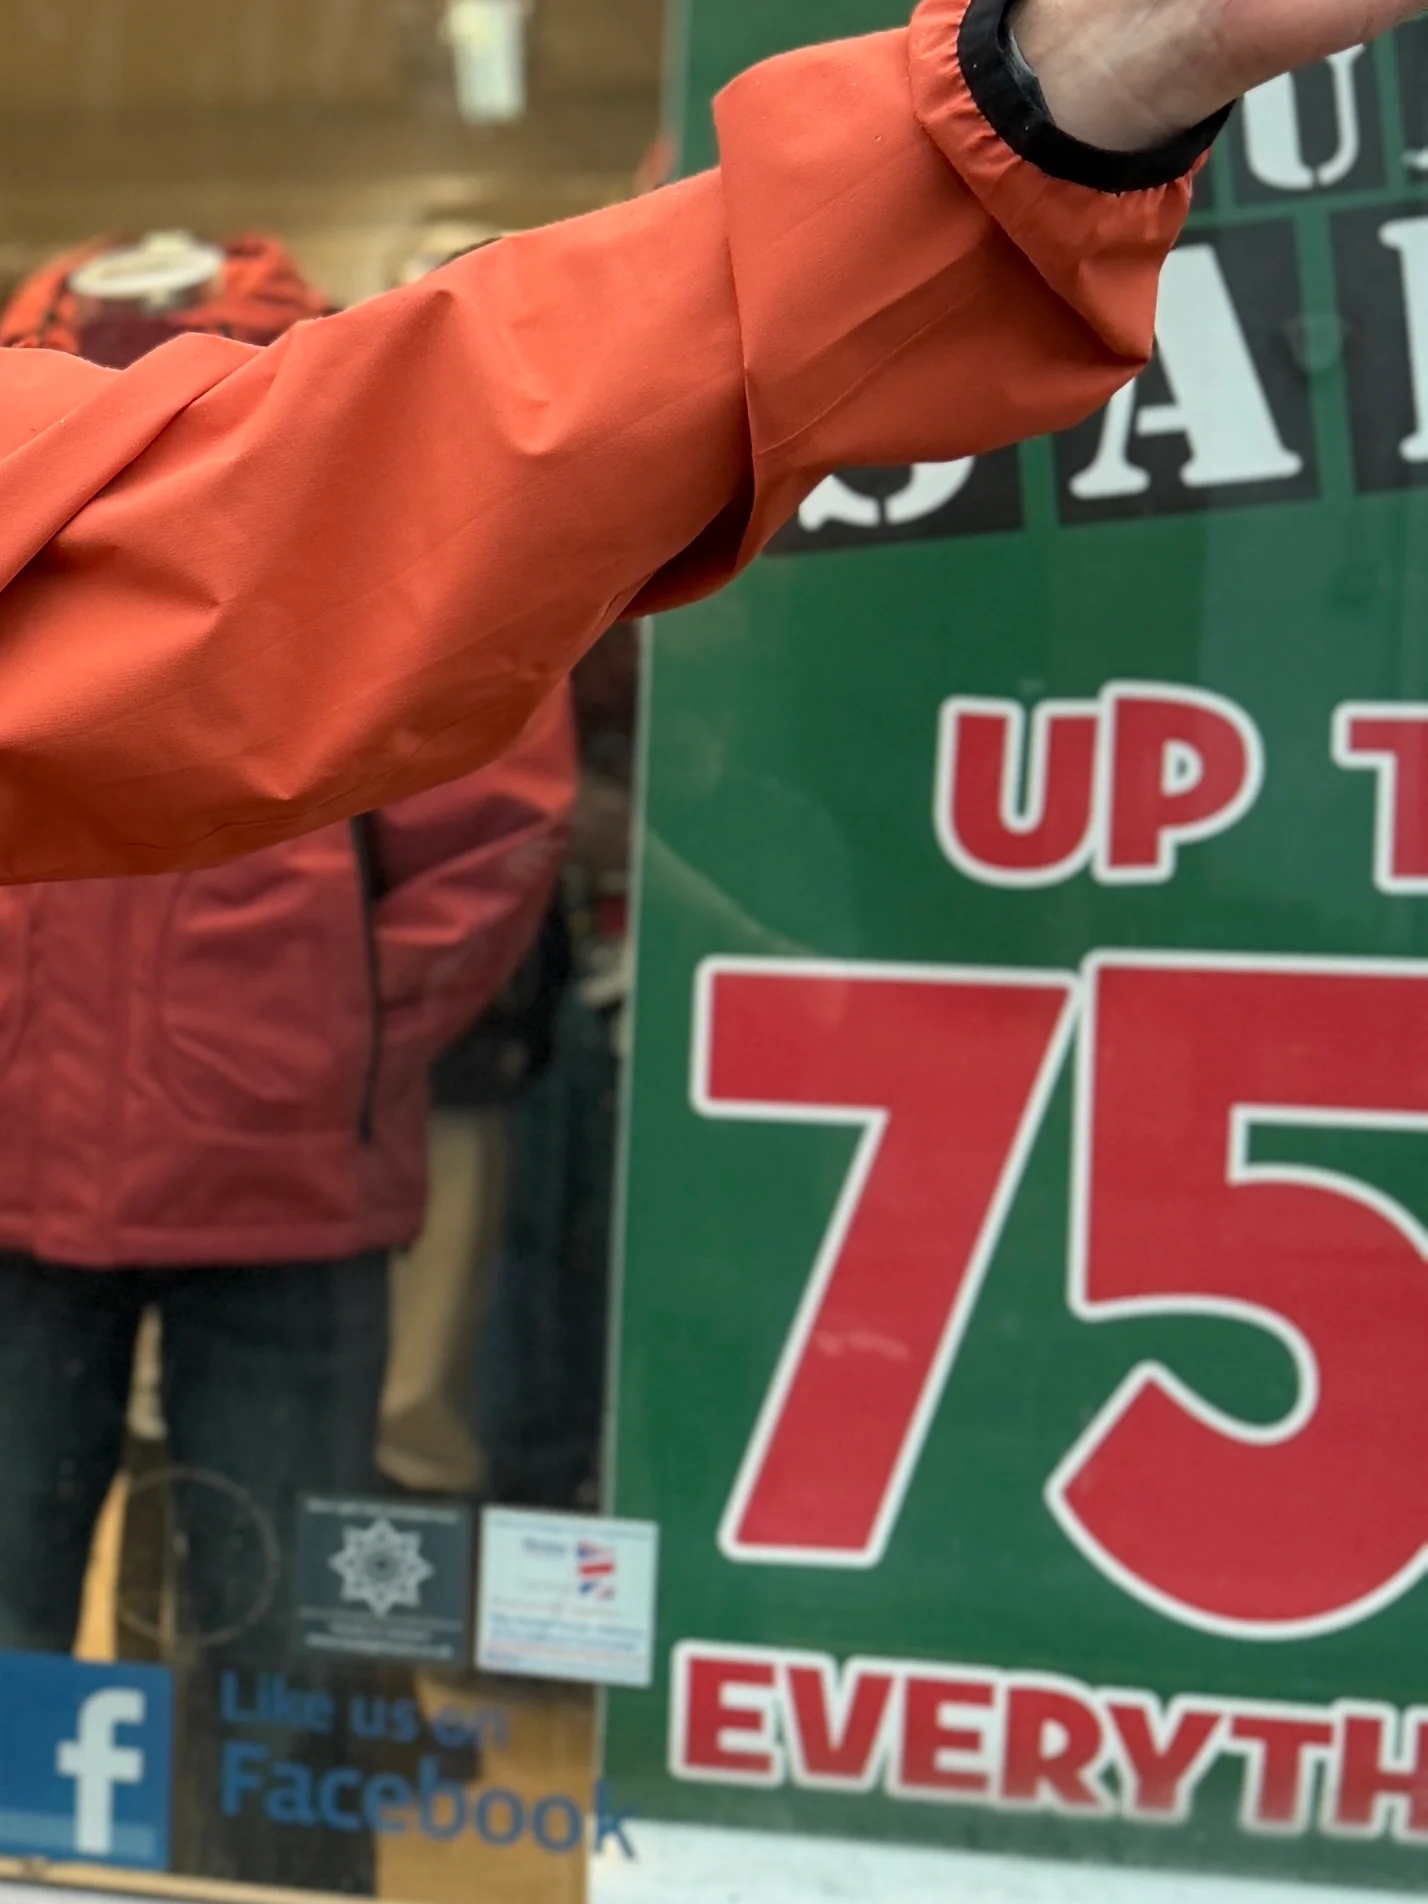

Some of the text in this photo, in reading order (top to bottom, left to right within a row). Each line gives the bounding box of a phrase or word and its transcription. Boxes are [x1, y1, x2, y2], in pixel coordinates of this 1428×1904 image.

[933, 680, 1264, 888] UP
[218, 1669, 510, 1751] Like us on
[218, 1739, 640, 1862] Facebook
